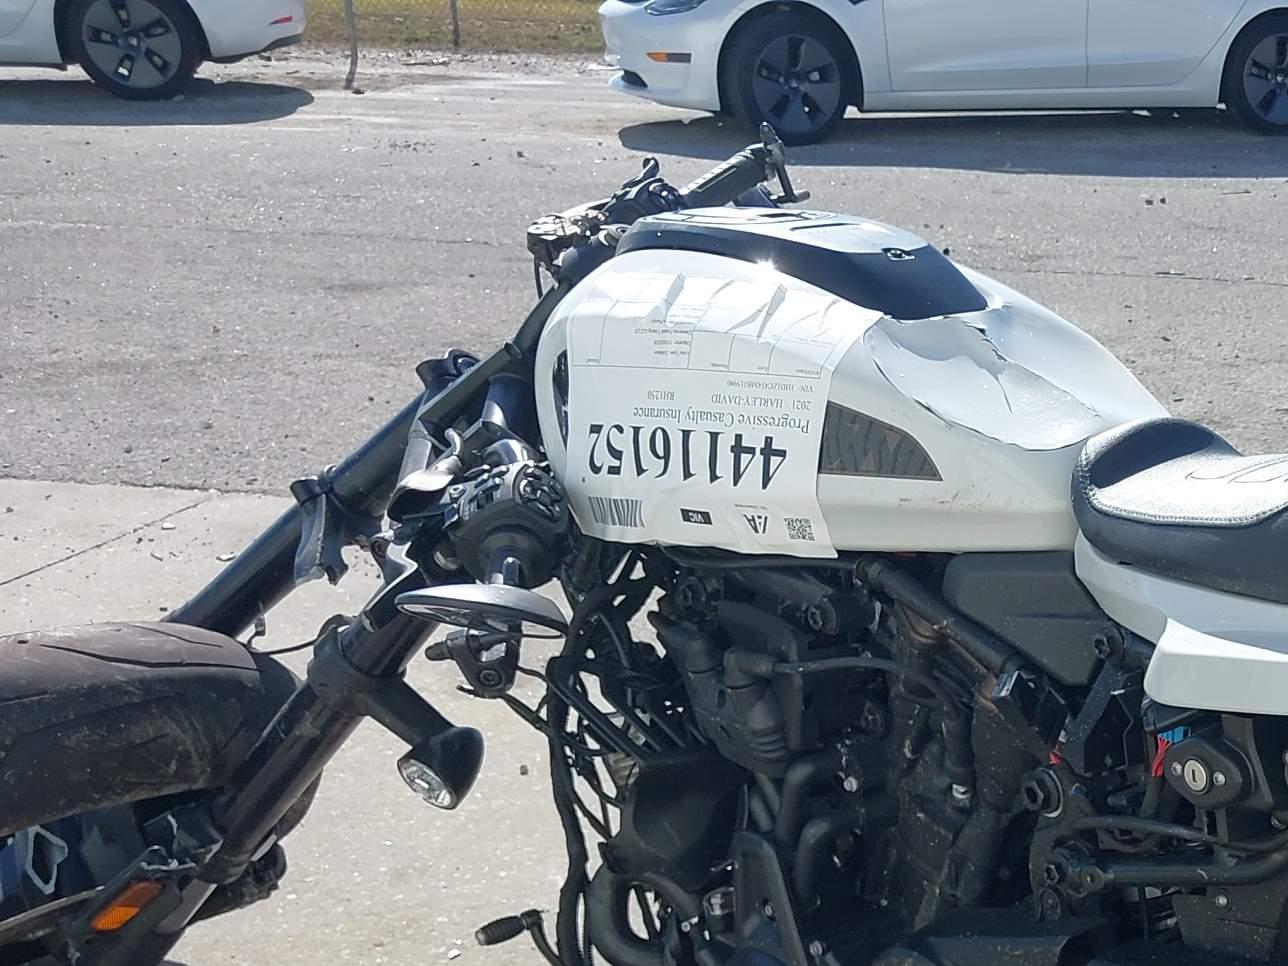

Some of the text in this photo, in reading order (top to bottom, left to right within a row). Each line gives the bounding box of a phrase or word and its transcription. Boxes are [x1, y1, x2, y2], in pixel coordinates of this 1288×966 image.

[647, 390, 812, 411] 2021 HARLEY-DAVID RH1250
[632, 406, 810, 434] Progressive Casualty Insurance
[588, 423, 787, 490] 44116152
[688, 511, 705, 523] VIC
